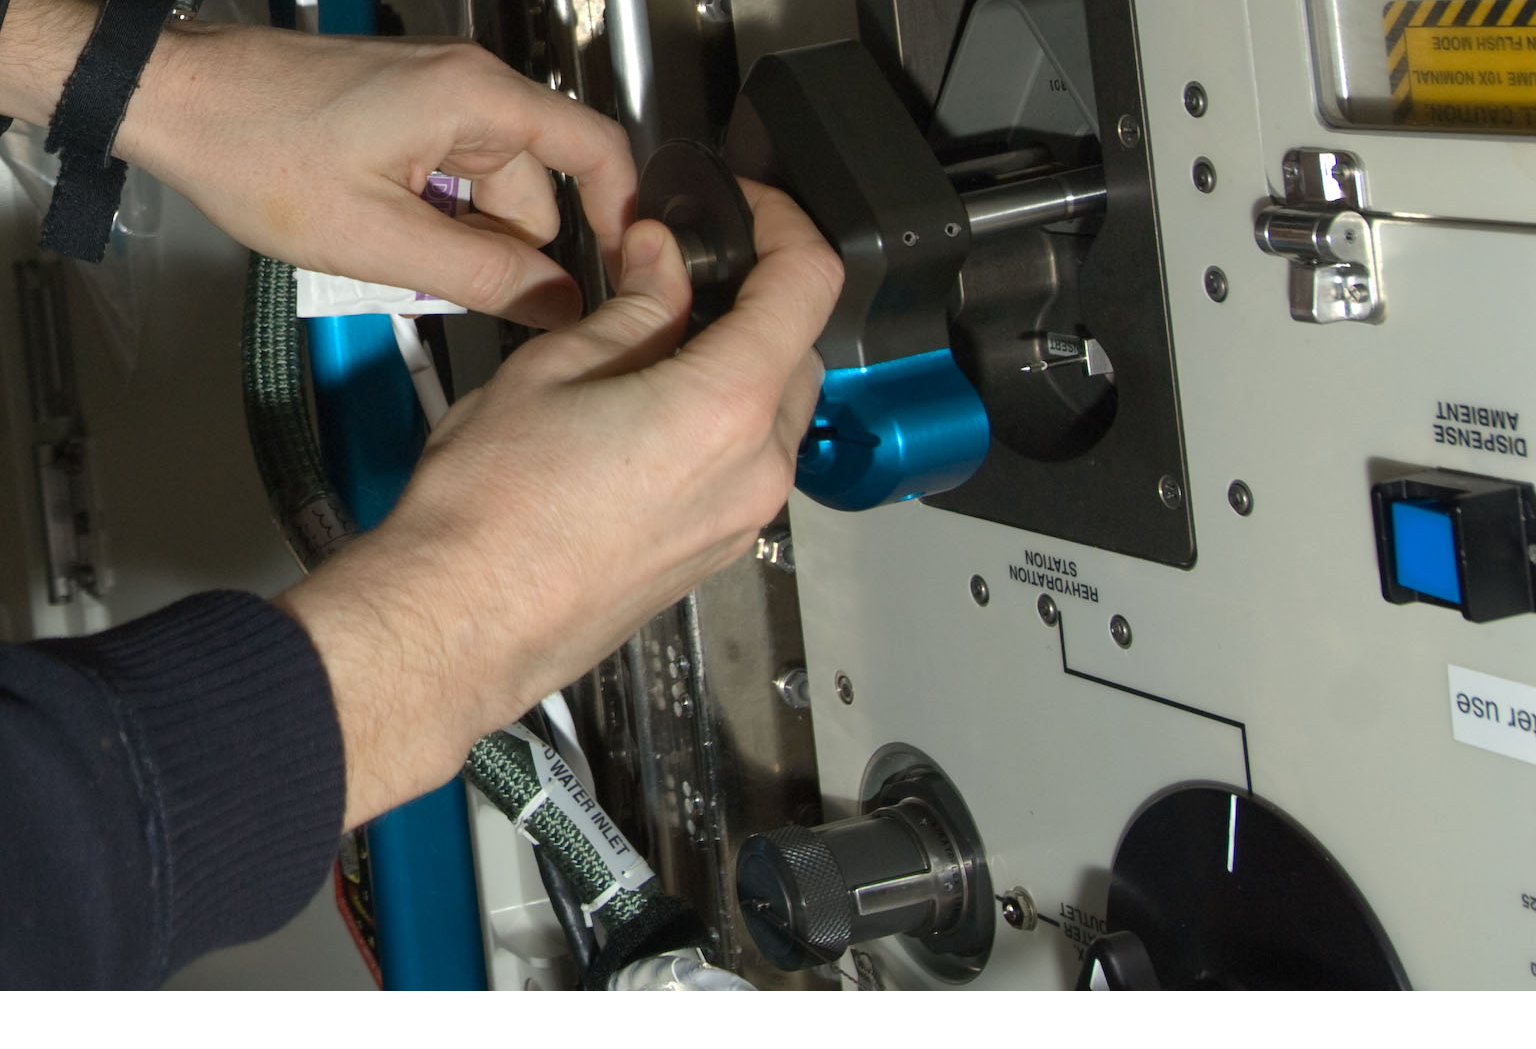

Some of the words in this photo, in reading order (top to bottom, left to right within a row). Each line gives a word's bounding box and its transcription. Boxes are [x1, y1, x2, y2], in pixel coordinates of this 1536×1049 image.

[1431, 36, 1471, 50] MODE
[1476, 36, 1521, 49] FLUSH
[1411, 70, 1473, 83] NOMINAL
[1477, 71, 1502, 84] 10X
[1049, 341, 1077, 352] SERT
[1436, 401, 1517, 431] AMBIENT
[1433, 424, 1526, 457] DISPENSE
[1024, 549, 1076, 576] STATION
[1009, 564, 1097, 602] REHYDRATION
[1452, 691, 1503, 722] use
[548, 759, 596, 812] WATER
[590, 811, 630, 857] INLET
[1063, 922, 1095, 945] ATER
